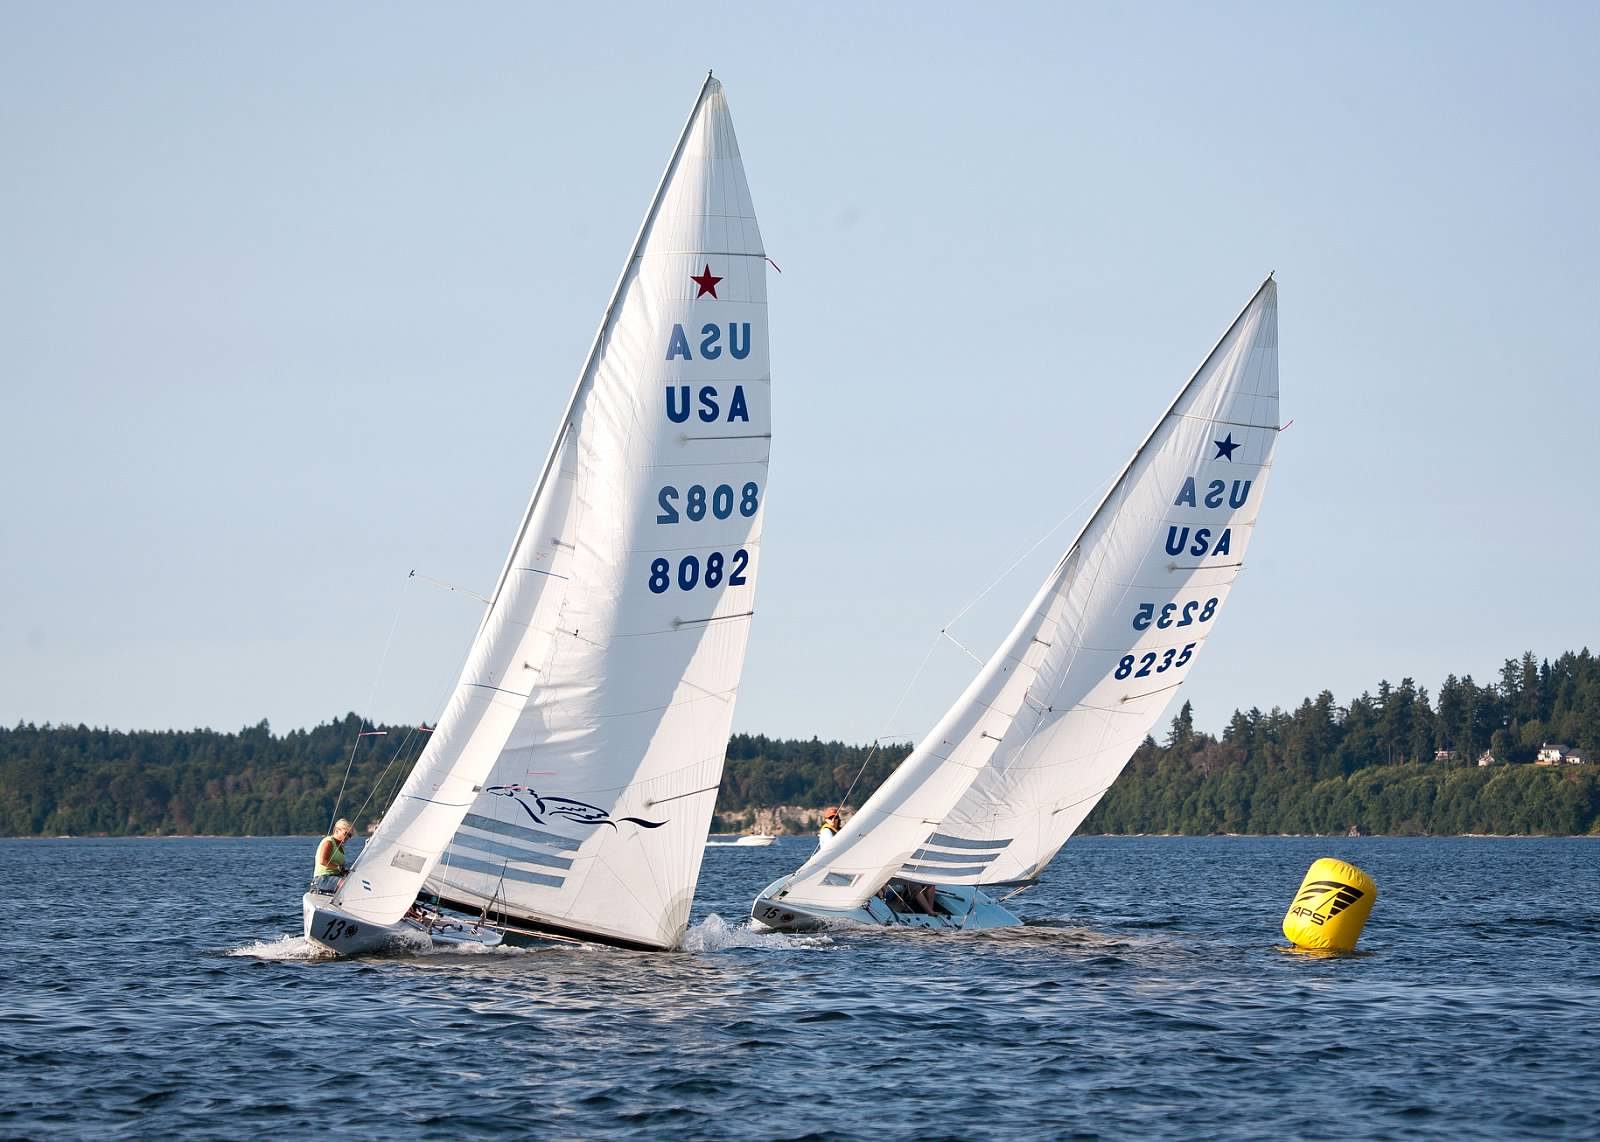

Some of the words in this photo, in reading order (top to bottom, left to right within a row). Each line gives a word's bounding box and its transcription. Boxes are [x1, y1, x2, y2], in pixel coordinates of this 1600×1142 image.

[665, 385, 750, 424] USA
[1165, 526, 1232, 557] USA
[648, 549, 749, 594] 8082
[1114, 642, 1197, 681] 8235
[762, 907, 780, 919] 15
[1292, 907, 1326, 926] APS
[322, 918, 346, 940] 13
